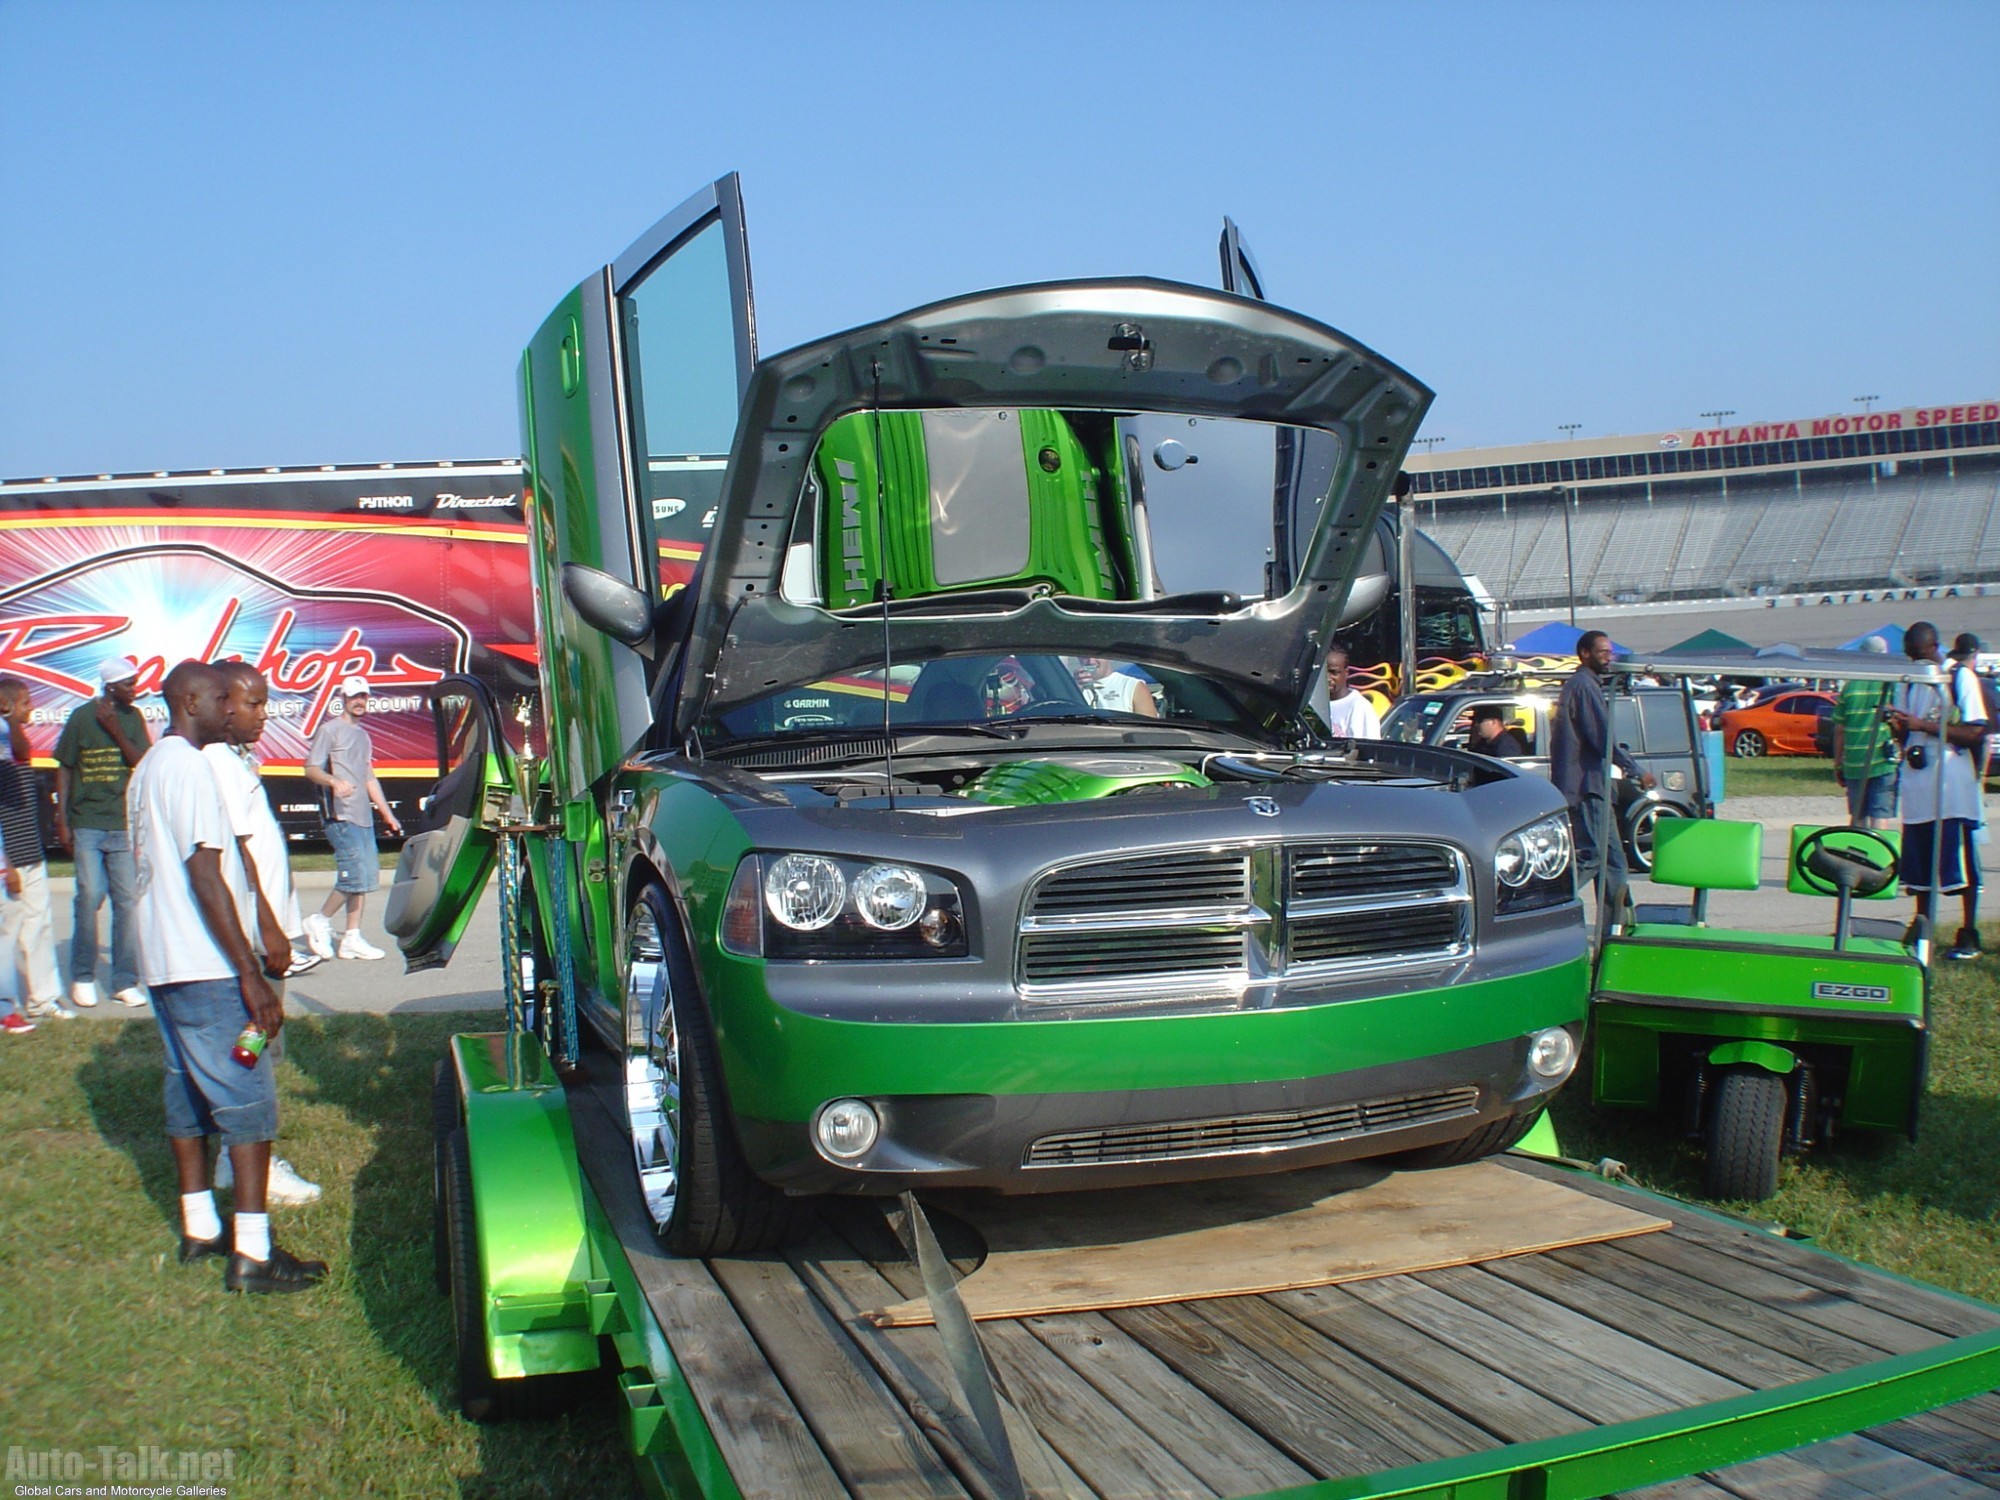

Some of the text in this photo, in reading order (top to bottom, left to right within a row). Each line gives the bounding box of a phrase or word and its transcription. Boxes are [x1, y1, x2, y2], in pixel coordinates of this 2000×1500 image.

[1692, 422, 1799, 448] ATLANTA
[1812, 413, 1902, 436] MOTOR
[359, 495, 413, 509] PYTHON
[436, 493, 517, 509] Directed
[654, 505, 680, 513] SUNG
[1819, 588, 1959, 605] ATLANTA
[792, 698, 830, 709] GARMIN
